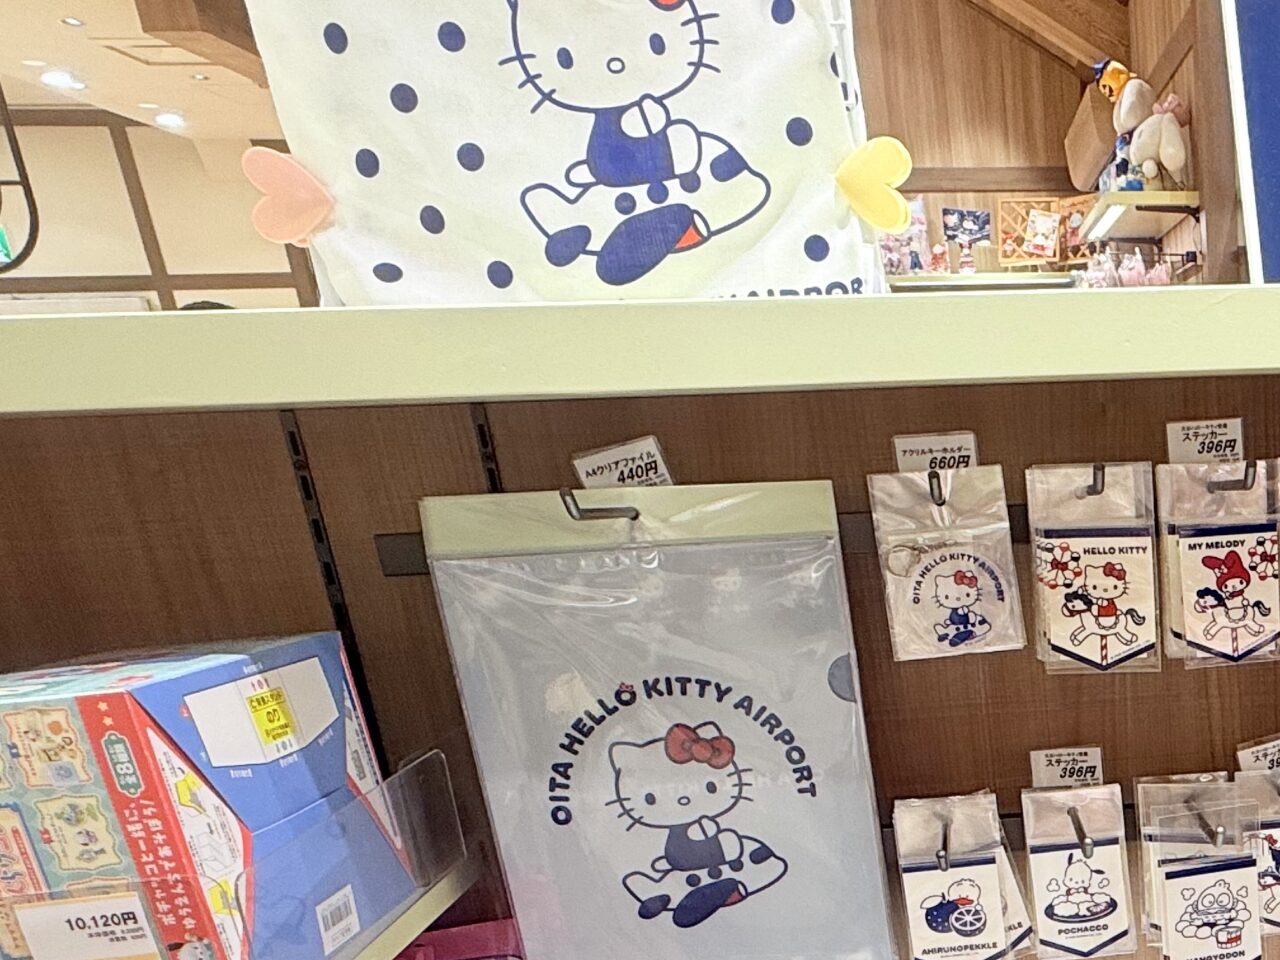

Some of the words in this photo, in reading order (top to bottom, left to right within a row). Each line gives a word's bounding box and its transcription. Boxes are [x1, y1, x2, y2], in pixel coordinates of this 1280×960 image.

[1182, 430, 1228, 442] ステッカー
[1197, 439, 1237, 454] 396円
[584, 451, 656, 478] A4クリアファイル
[929, 455, 971, 469] 660円
[617, 460, 658, 484] 440円
[1083, 546, 1115, 556] HELLO
[1118, 545, 1148, 555] KITTY
[1187, 541, 1203, 551] MY
[1205, 539, 1247, 549] MELODY
[913, 580, 924, 605] OITA
[919, 554, 948, 579] HELLO
[949, 553, 980, 564] KITTY
[978, 562, 1005, 602] AIRPORT
[642, 676, 734, 704] KITTY
[560, 684, 637, 757] HELLO
[733, 696, 818, 798] AIRPORT
[1045, 758, 1088, 767] ステッカー
[1060, 765, 1097, 778] 396円
[551, 760, 574, 826] OITA
[65, 911, 138, 931] 10,120円
[1058, 923, 1109, 937] POCHACCO
[921, 942, 998, 956] AHIRUNOPEKKLE
